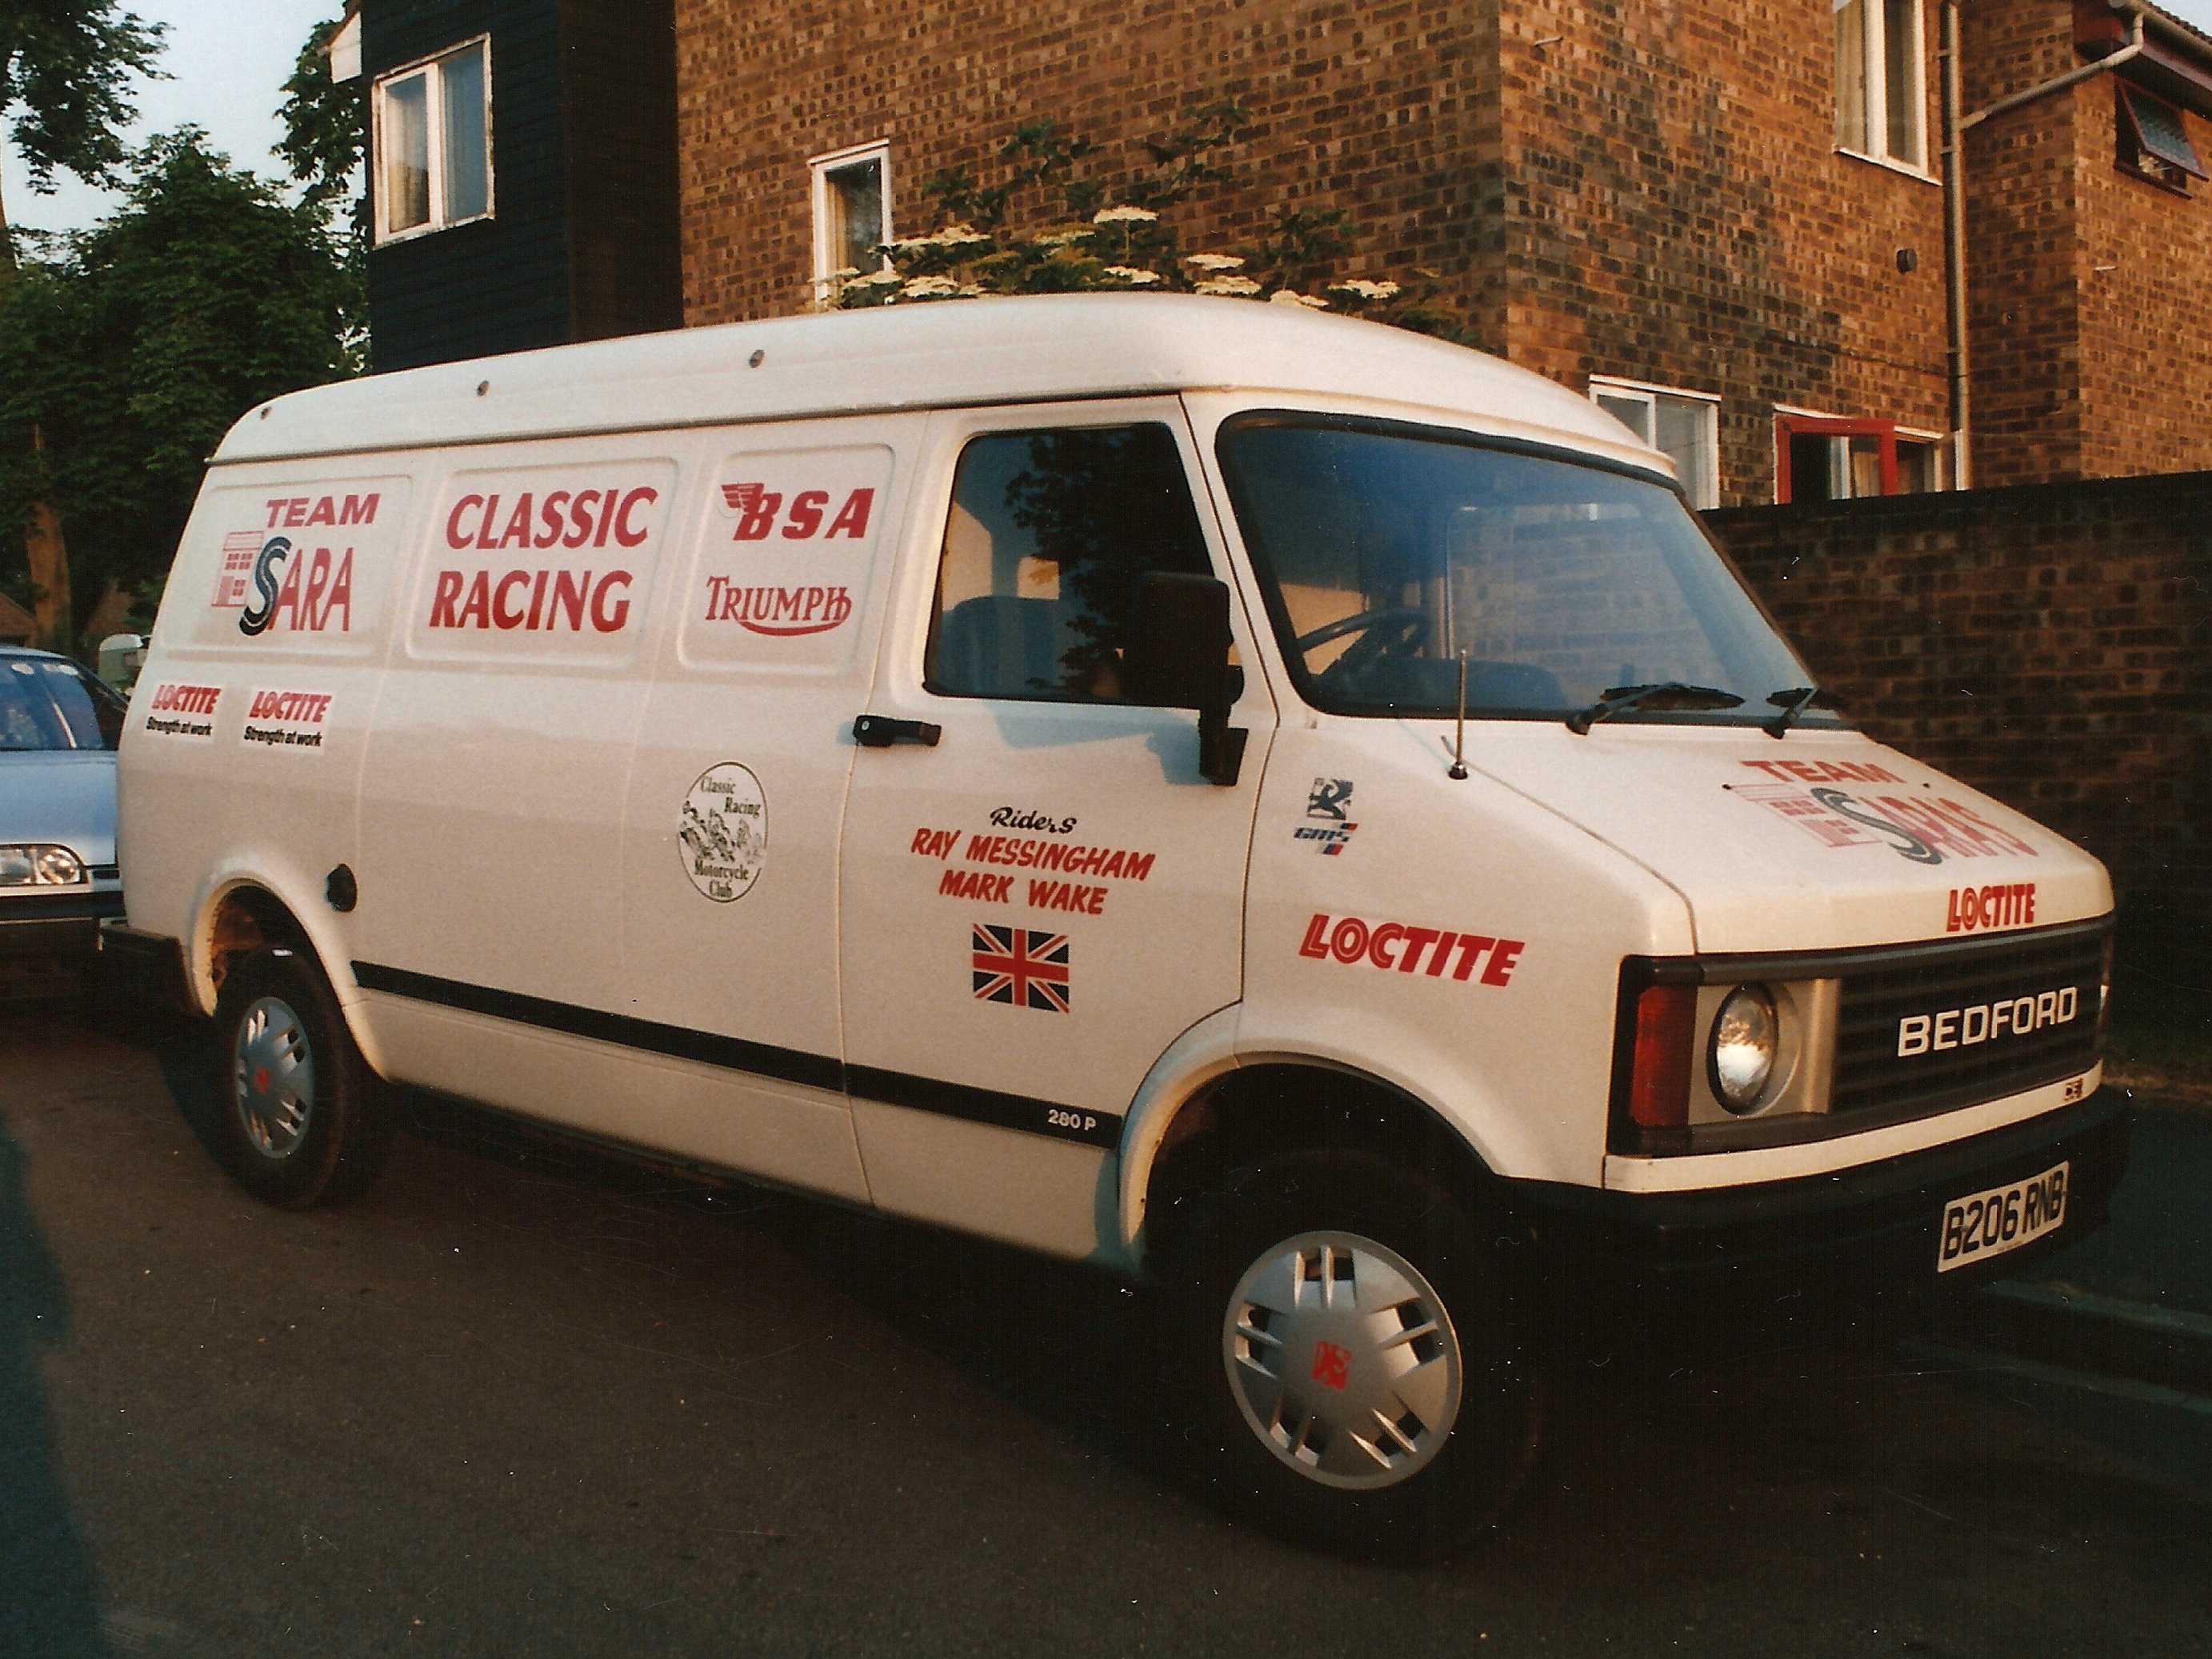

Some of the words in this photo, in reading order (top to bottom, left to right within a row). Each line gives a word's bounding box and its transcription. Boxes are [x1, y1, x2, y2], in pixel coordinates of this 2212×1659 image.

[267, 494, 380, 528] TEAM
[446, 487, 658, 549] CLASSIC
[722, 482, 875, 541] BSA
[239, 536, 354, 636] SARA
[429, 570, 633, 632] RACING
[705, 576, 853, 637] TRIUMPH
[152, 685, 221, 714] LOCTITE
[250, 691, 332, 722] LOCTITE
[190, 723, 212, 735] work
[244, 726, 285, 746] Strength
[285, 730, 297, 744] at
[297, 732, 322, 747] work
[701, 774, 736, 794] Classic
[1740, 761, 1907, 783] TEAM
[724, 797, 761, 818] Racing
[990, 806, 1077, 834] Riders
[694, 859, 749, 880] Motorcycle
[910, 827, 961, 860] RAY
[966, 834, 1156, 881] MESSINGHAM
[710, 879, 732, 897] Club
[938, 869, 1014, 903] MARK
[1028, 878, 1108, 914] WAKE
[1946, 883, 2035, 932] LOCTITE
[1298, 913, 1525, 986] LOCTITE
[1898, 986, 2078, 1057] BEDFORD
[1048, 1109, 1081, 1129] 280
[1084, 1116, 1096, 1131] P
[1943, 1190, 2021, 1260] B206
[2022, 1170, 2064, 1233] RNB
